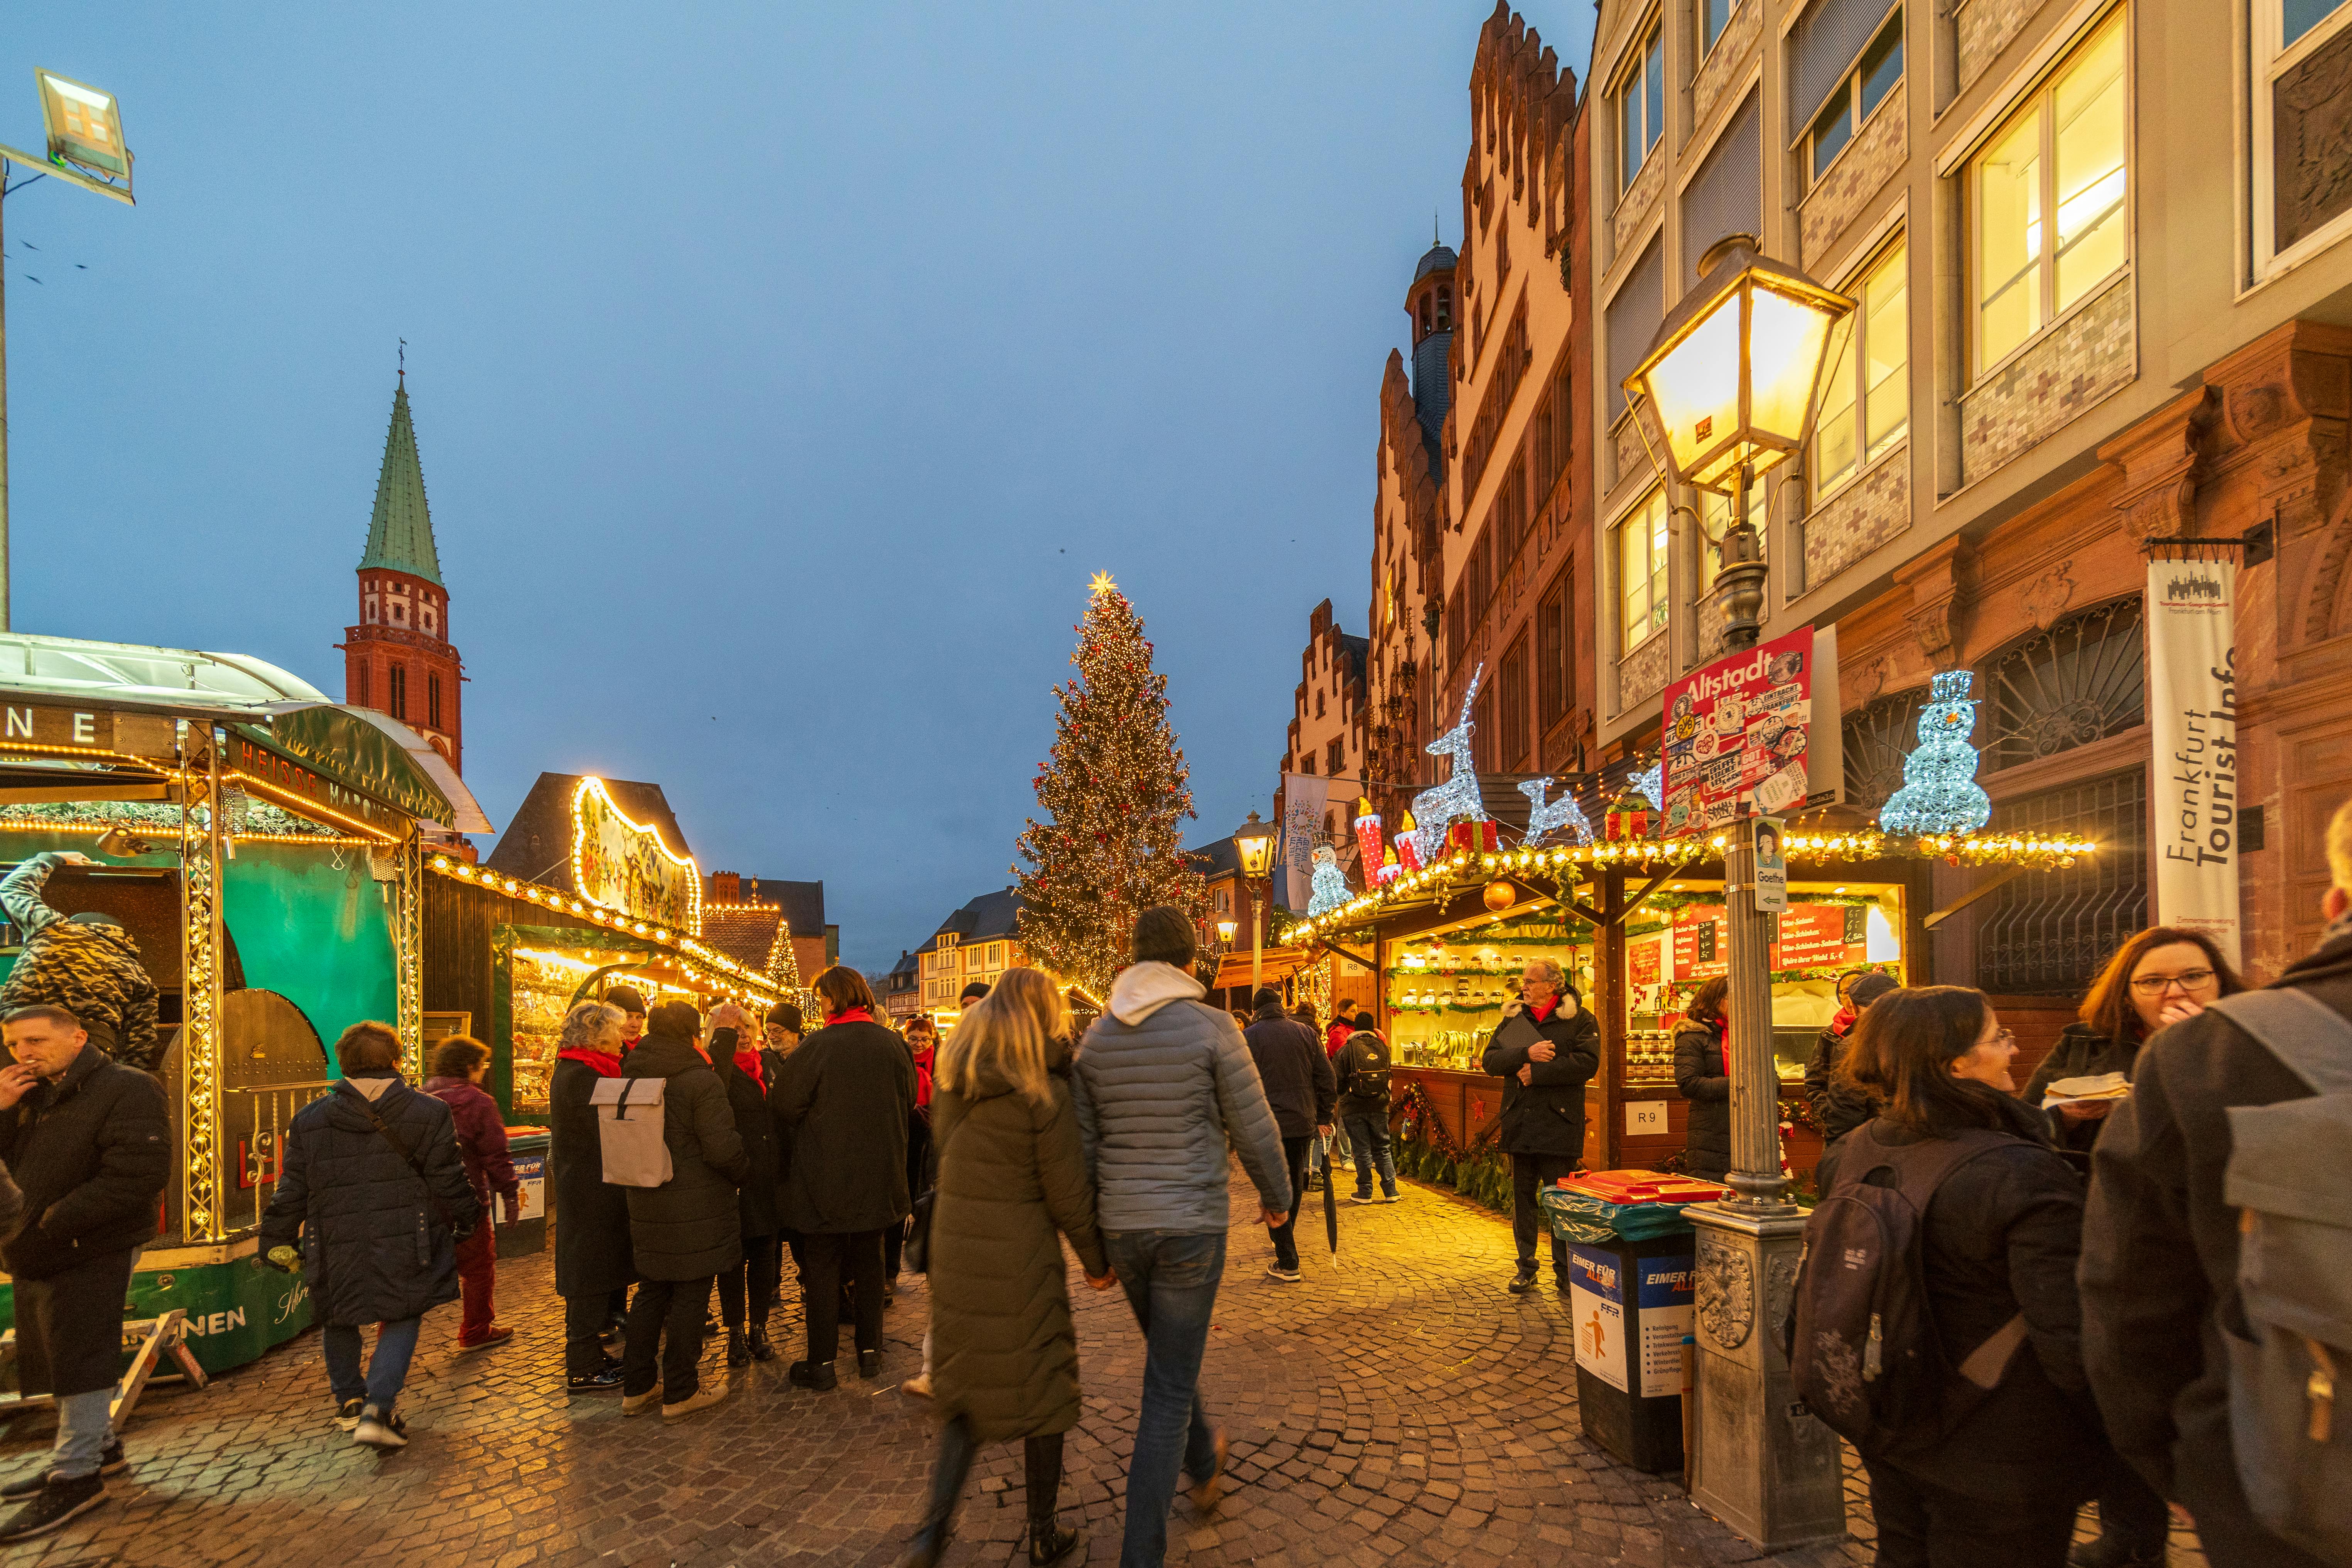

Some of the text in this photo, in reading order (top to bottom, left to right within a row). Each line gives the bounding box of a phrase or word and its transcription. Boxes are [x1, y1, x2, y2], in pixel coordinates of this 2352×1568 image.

[1687, 650, 1775, 703] Altstadt
[1764, 684, 1798, 701] EINTRACHT
[1763, 694, 1798, 712] FRANKFURT
[242, 741, 399, 832] HEISSE MARONEN
[2166, 709, 2206, 862] Frankfurt
[2197, 736, 2236, 867] Tourist
[1758, 871, 1784, 884] Goethe
[1781, 916, 1815, 927] Käse-Salami
[1781, 930, 1820, 940] Käse-Schinken
[1781, 939, 1842, 952] Käse-Schinken-Salami
[1782, 957, 1798, 966] Liköre
[1798, 955, 1812, 964] ihrer
[1812, 953, 1829, 962] Wahl
[1839, 951, 1844, 959] €
[1638, 1112, 1656, 1123] R 9
[1572, 1253, 1616, 1281] EIMER FÜR
[1646, 1271, 1687, 1285] EIMER
[1671, 1281, 1695, 1292] ALL
[1601, 1302, 1619, 1318] FFR
